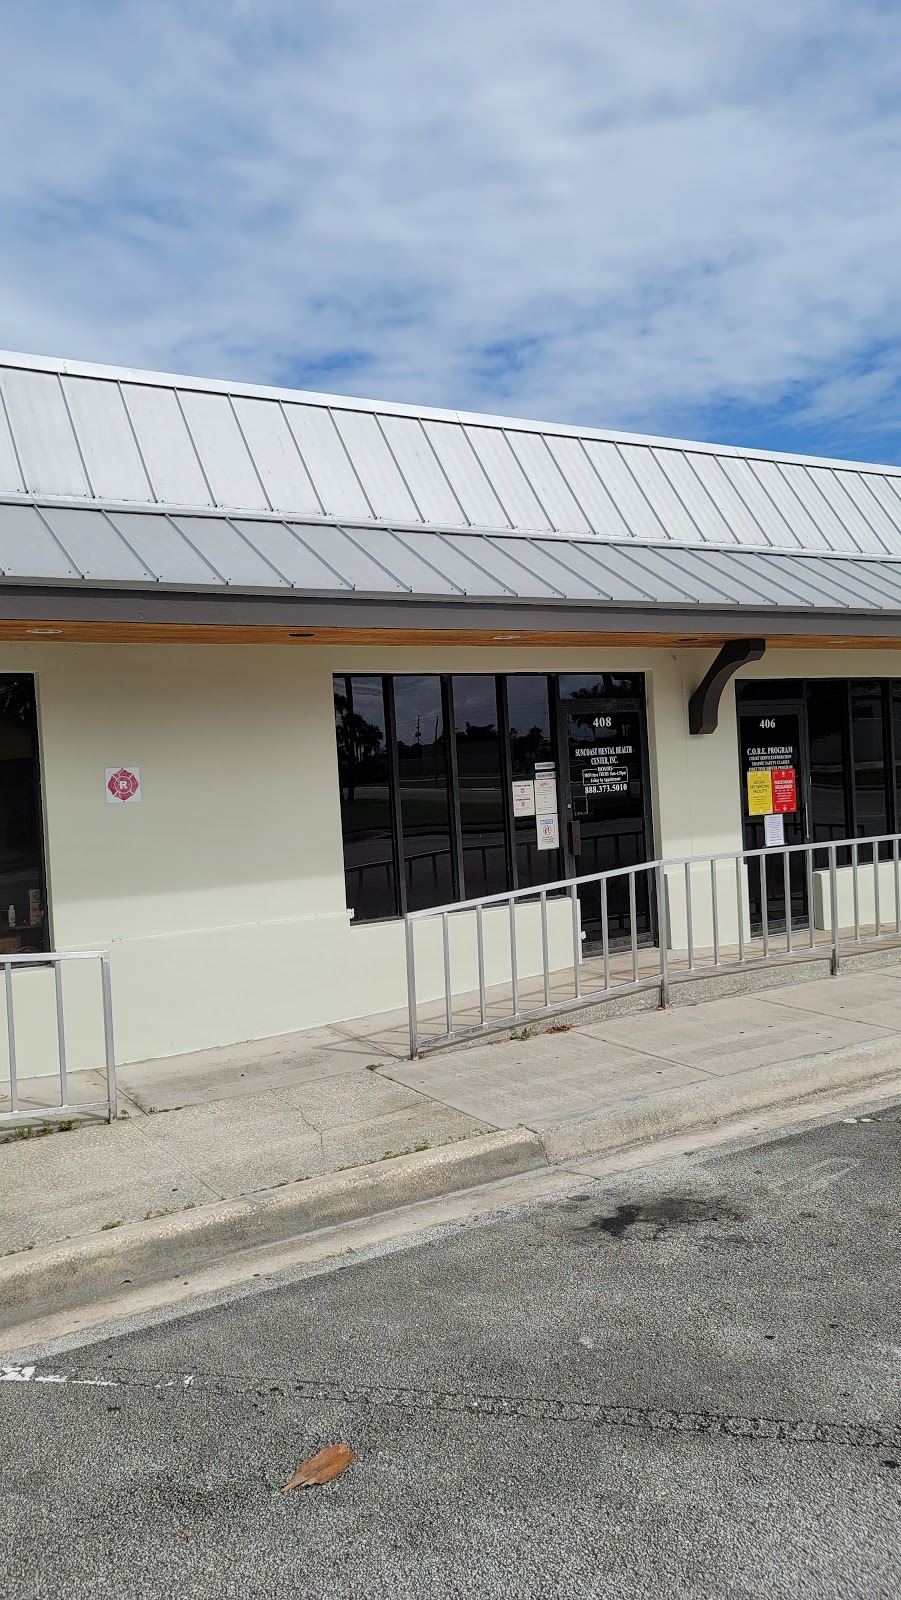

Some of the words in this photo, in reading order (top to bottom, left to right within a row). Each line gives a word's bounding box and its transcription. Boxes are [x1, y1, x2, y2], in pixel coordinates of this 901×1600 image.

[592, 717, 612, 727] 408
[759, 718, 776, 728] 406
[575, 748, 597, 756] SUNCOAST
[597, 747, 615, 755] MENTAL
[615, 746, 632, 754] HEALTH
[767, 746, 793, 754] PROGRAM
[609, 755, 619, 764] INC.
[119, 781, 128, 789] R
[585, 784, 627, 793] 888.373.5010
